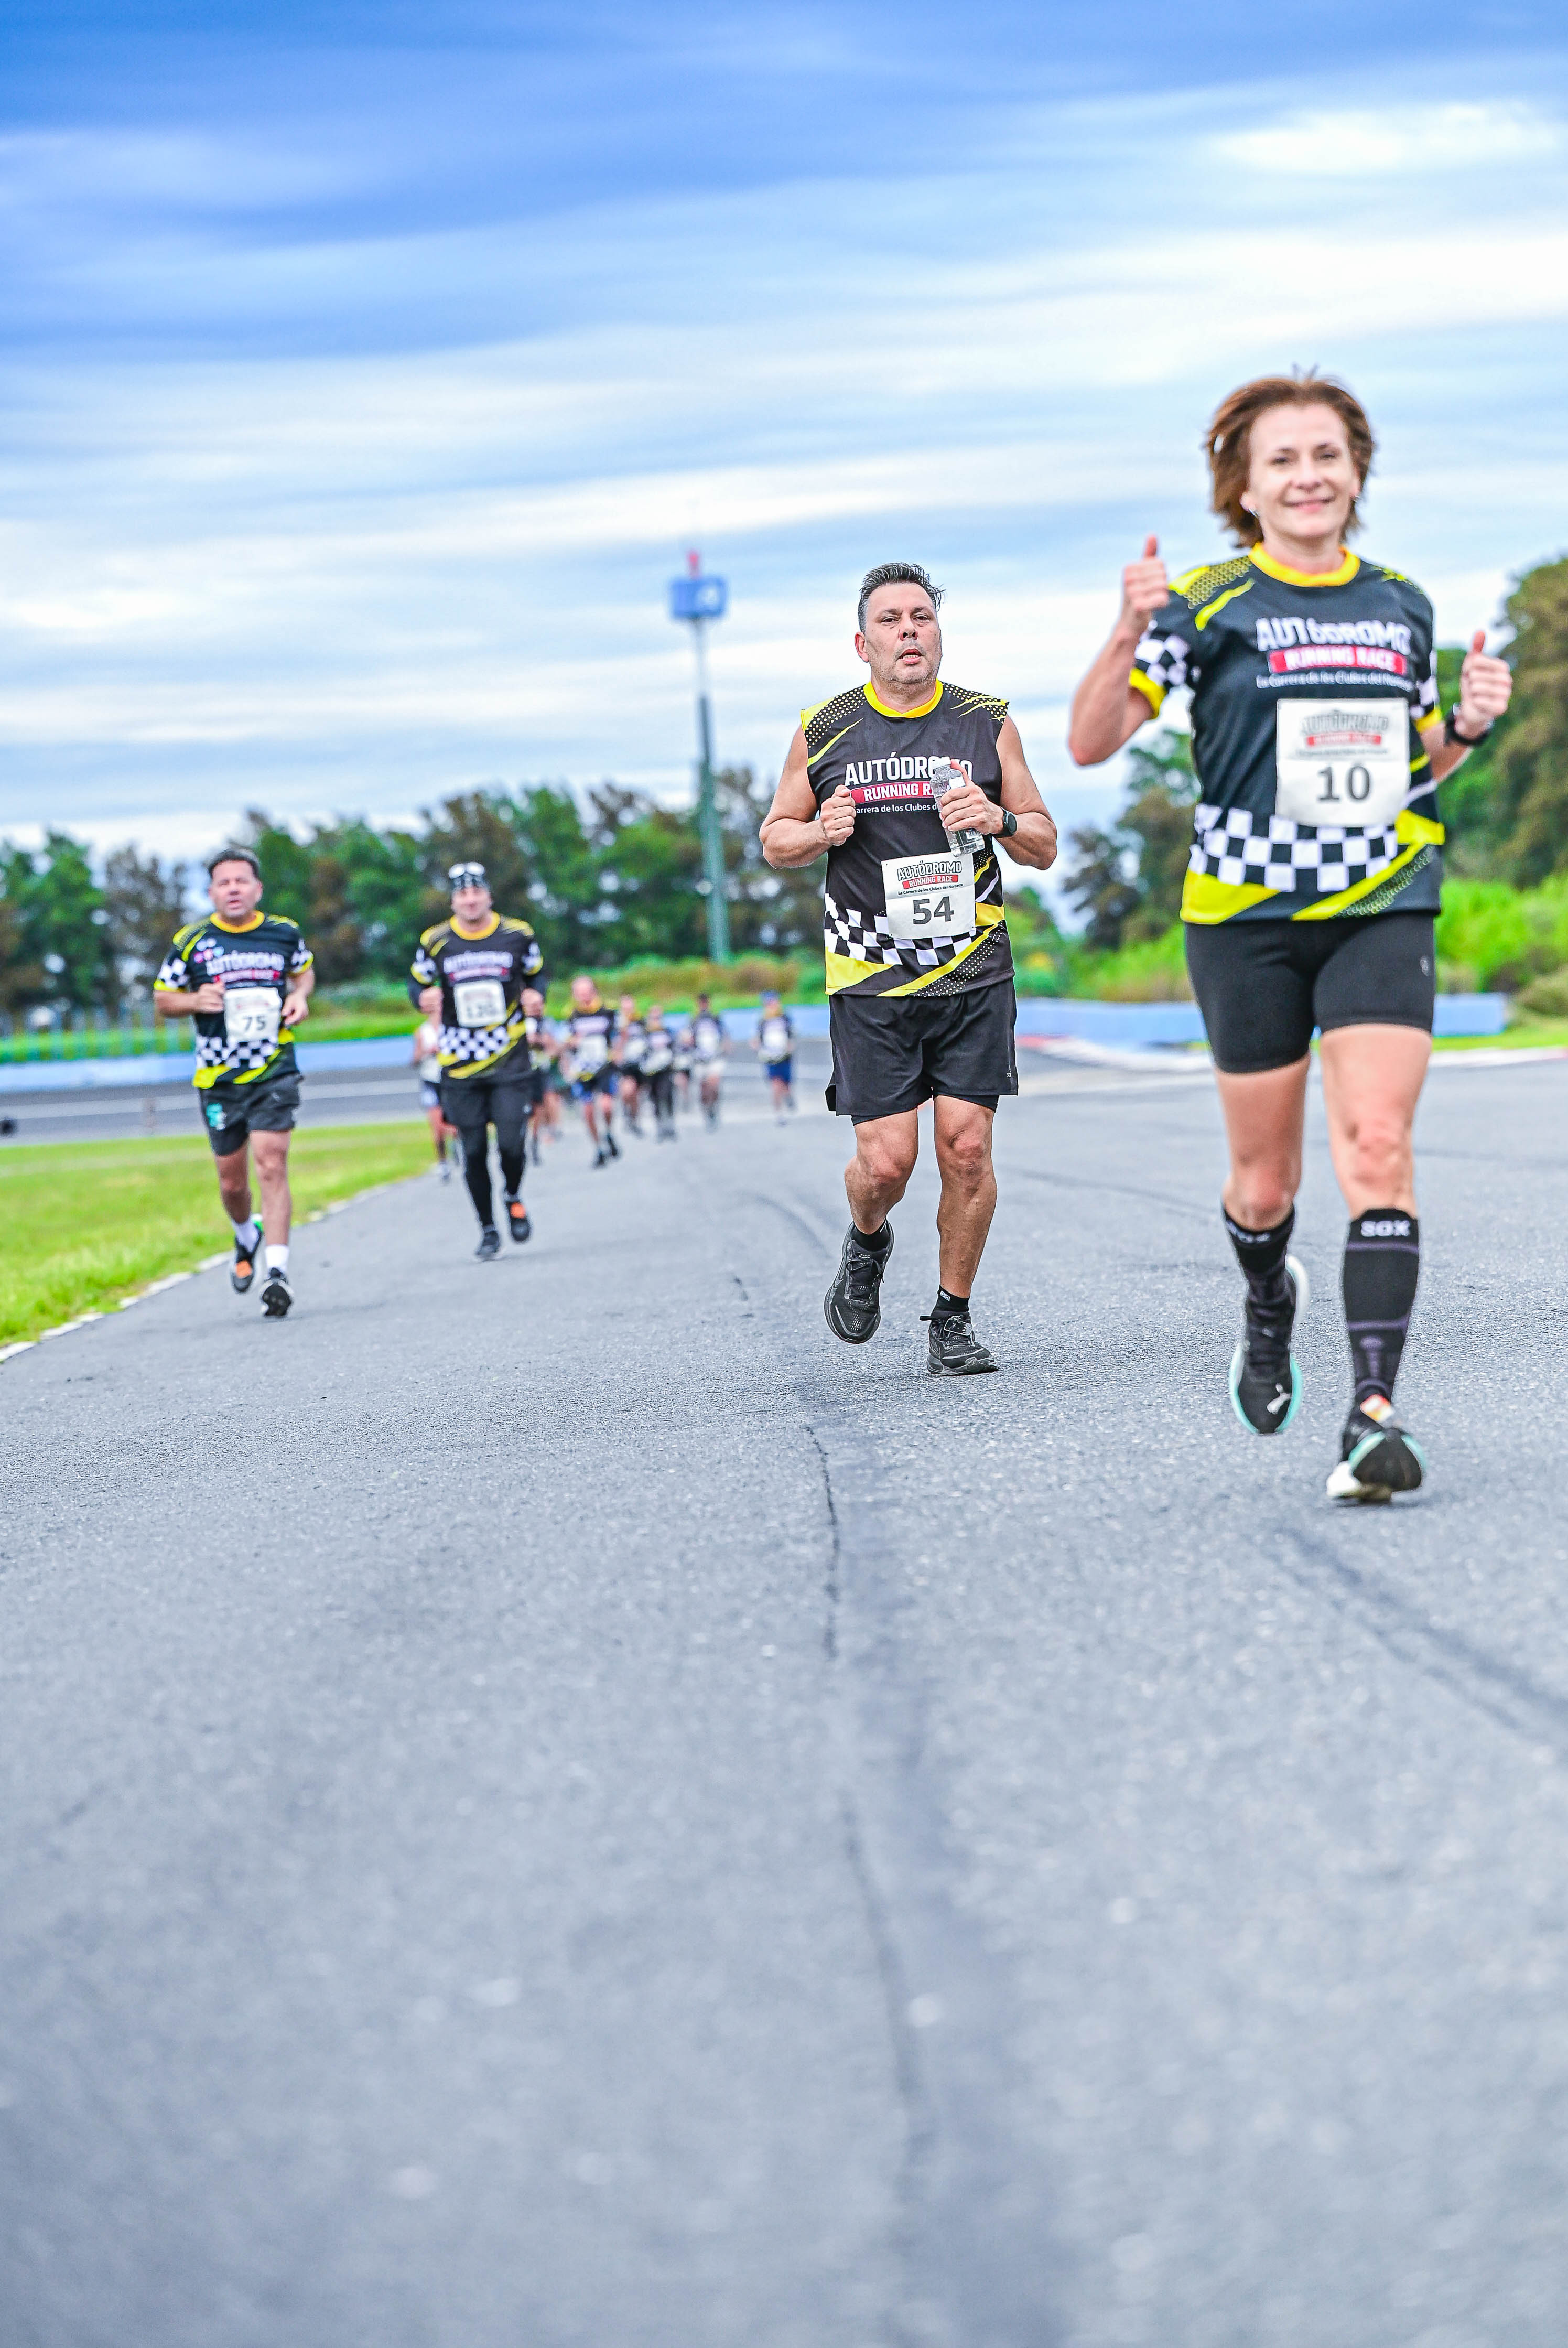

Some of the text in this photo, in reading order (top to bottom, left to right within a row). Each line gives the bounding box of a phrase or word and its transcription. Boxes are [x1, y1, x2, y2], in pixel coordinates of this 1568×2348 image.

[1284, 645, 1396, 672] RUNNING RACE
[863, 783, 918, 802] RUNNING
[1317, 765, 1371, 802] 10
[897, 860, 962, 881] AUTÓDROMO
[909, 877, 936, 888] RUNNING
[913, 896, 954, 925] 54
[243, 1015, 266, 1031] 75
